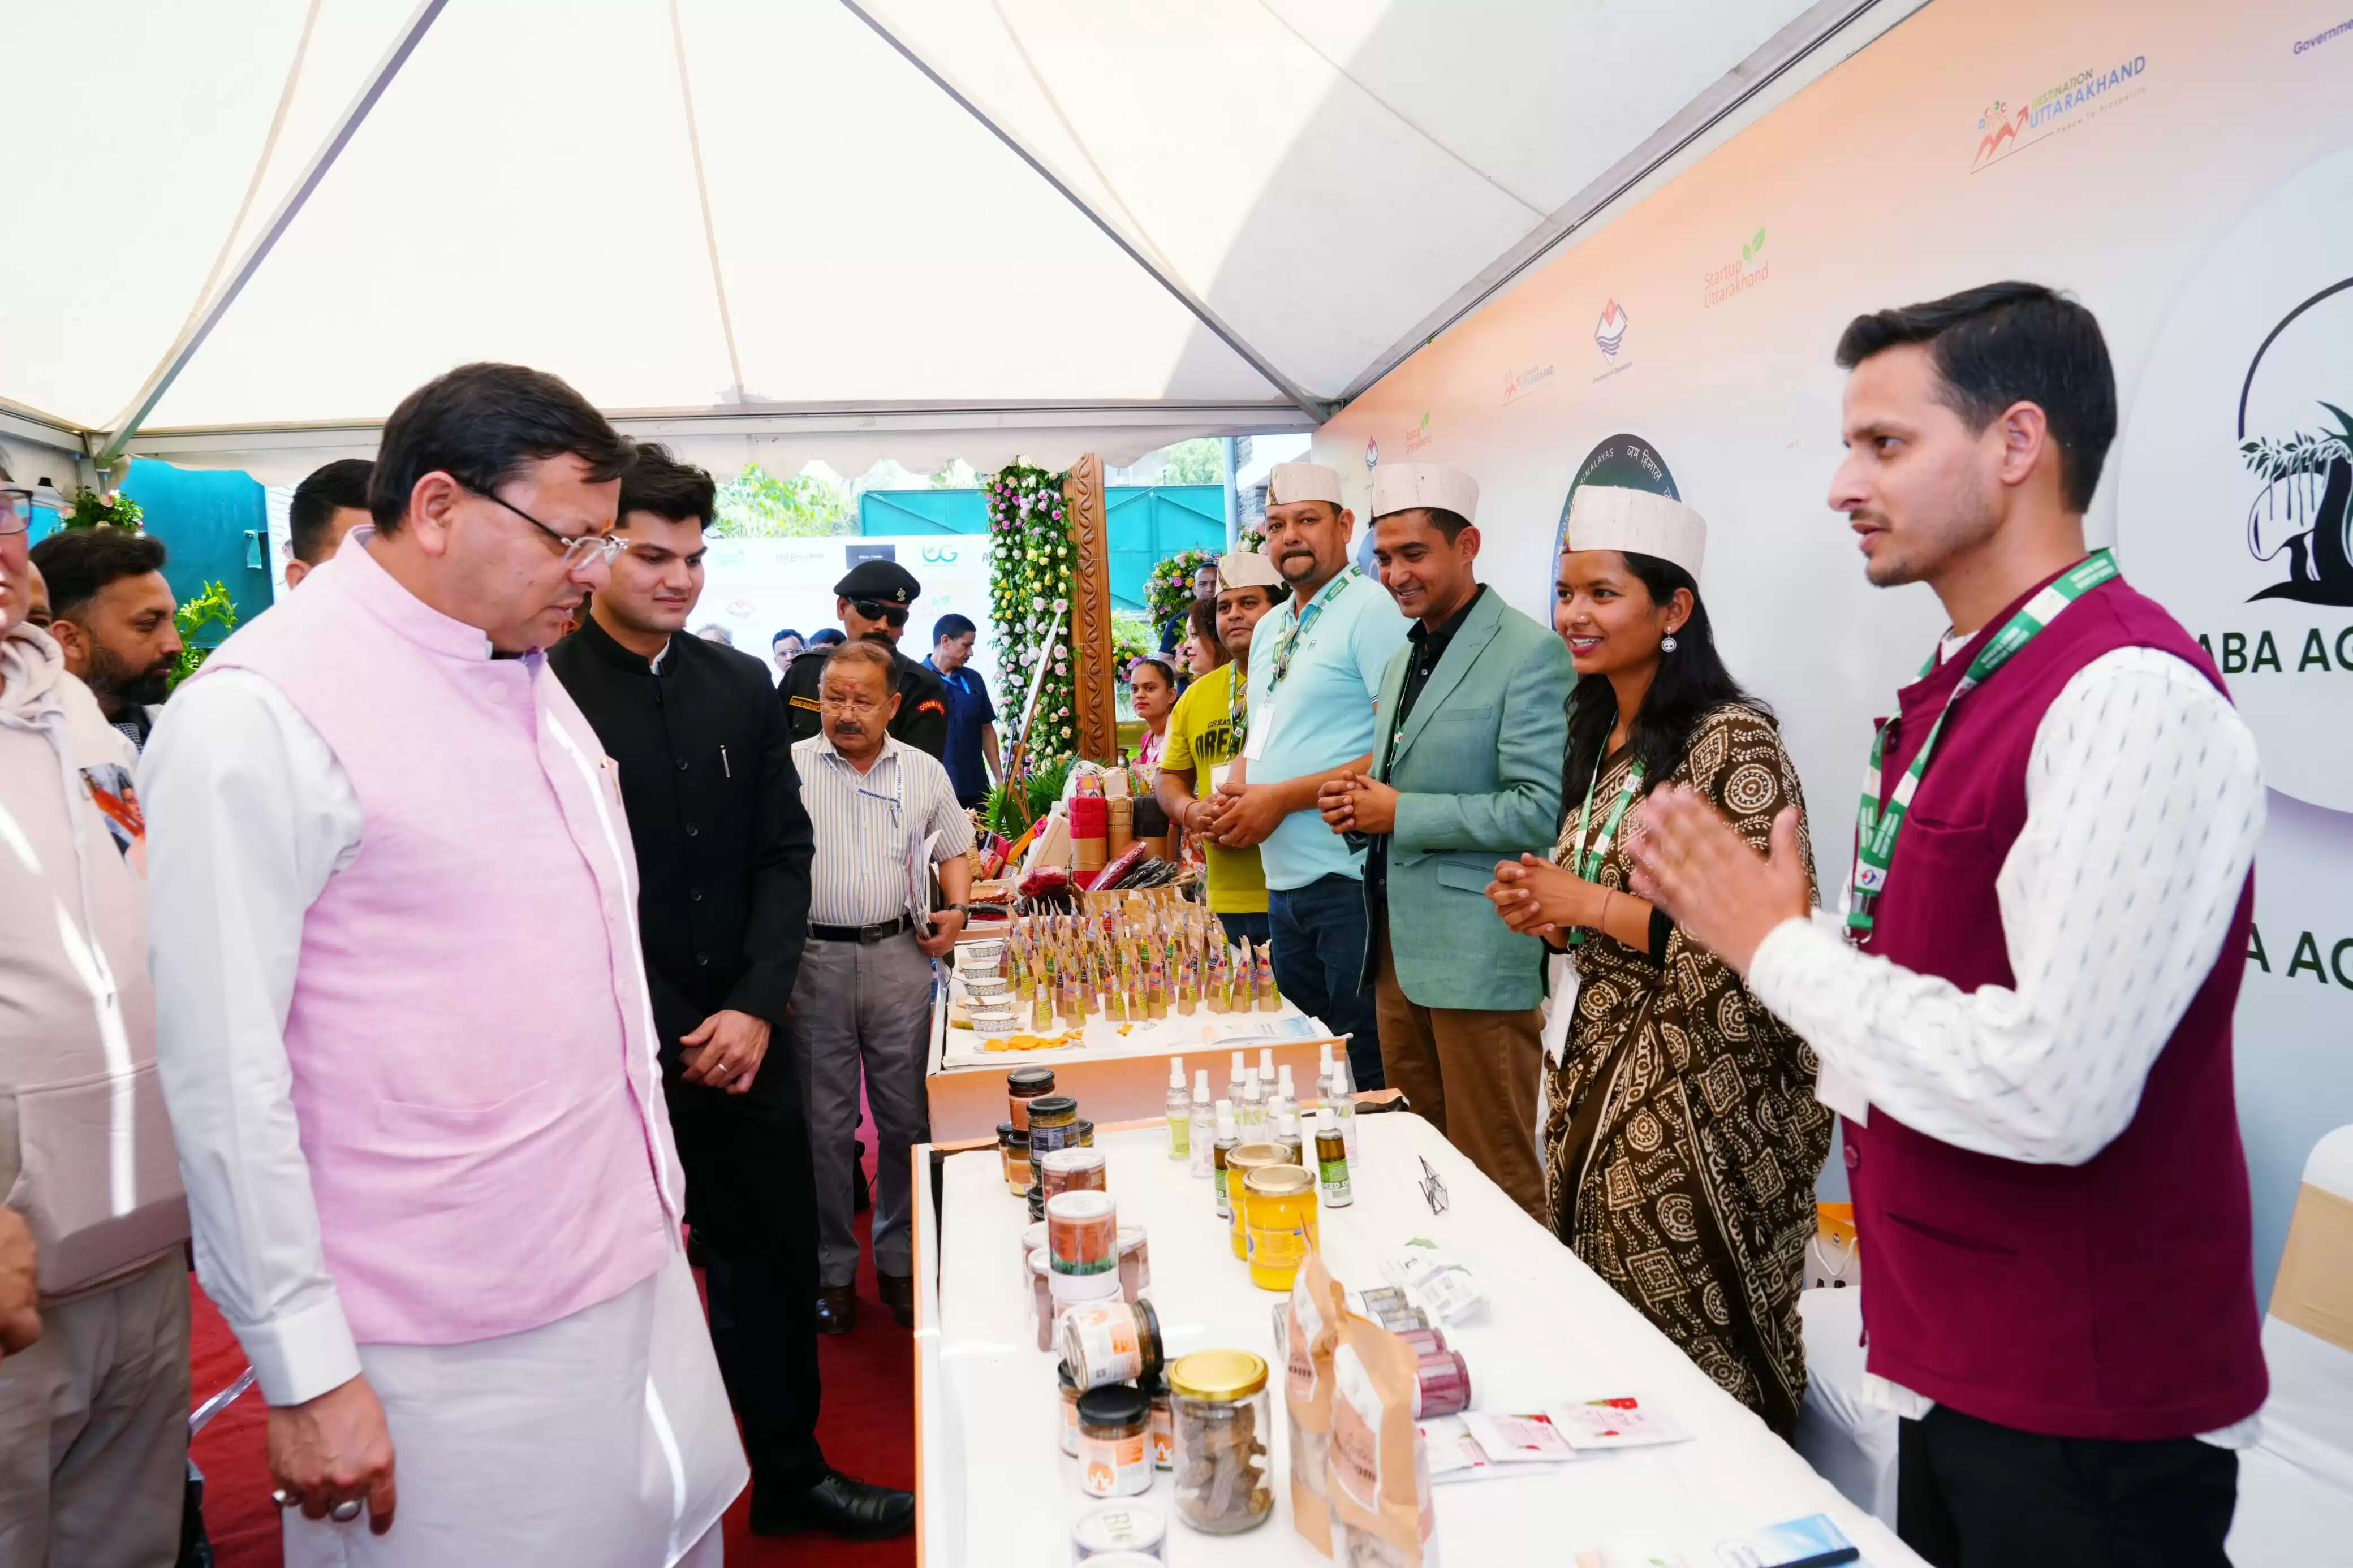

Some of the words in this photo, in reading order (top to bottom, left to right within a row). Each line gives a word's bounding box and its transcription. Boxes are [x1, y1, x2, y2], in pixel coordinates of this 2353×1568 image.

[2030, 55, 2145, 128] UTTARAKHAND
[2032, 68, 2093, 109] DESTINATION
[1705, 260, 1742, 290] Startup
[1705, 260, 1768, 308] Uttarakhand
[1579, 448, 1614, 485] HIMALAYAS
[1627, 445, 1640, 461] जय
[920, 701, 945, 715] COMMANDO
